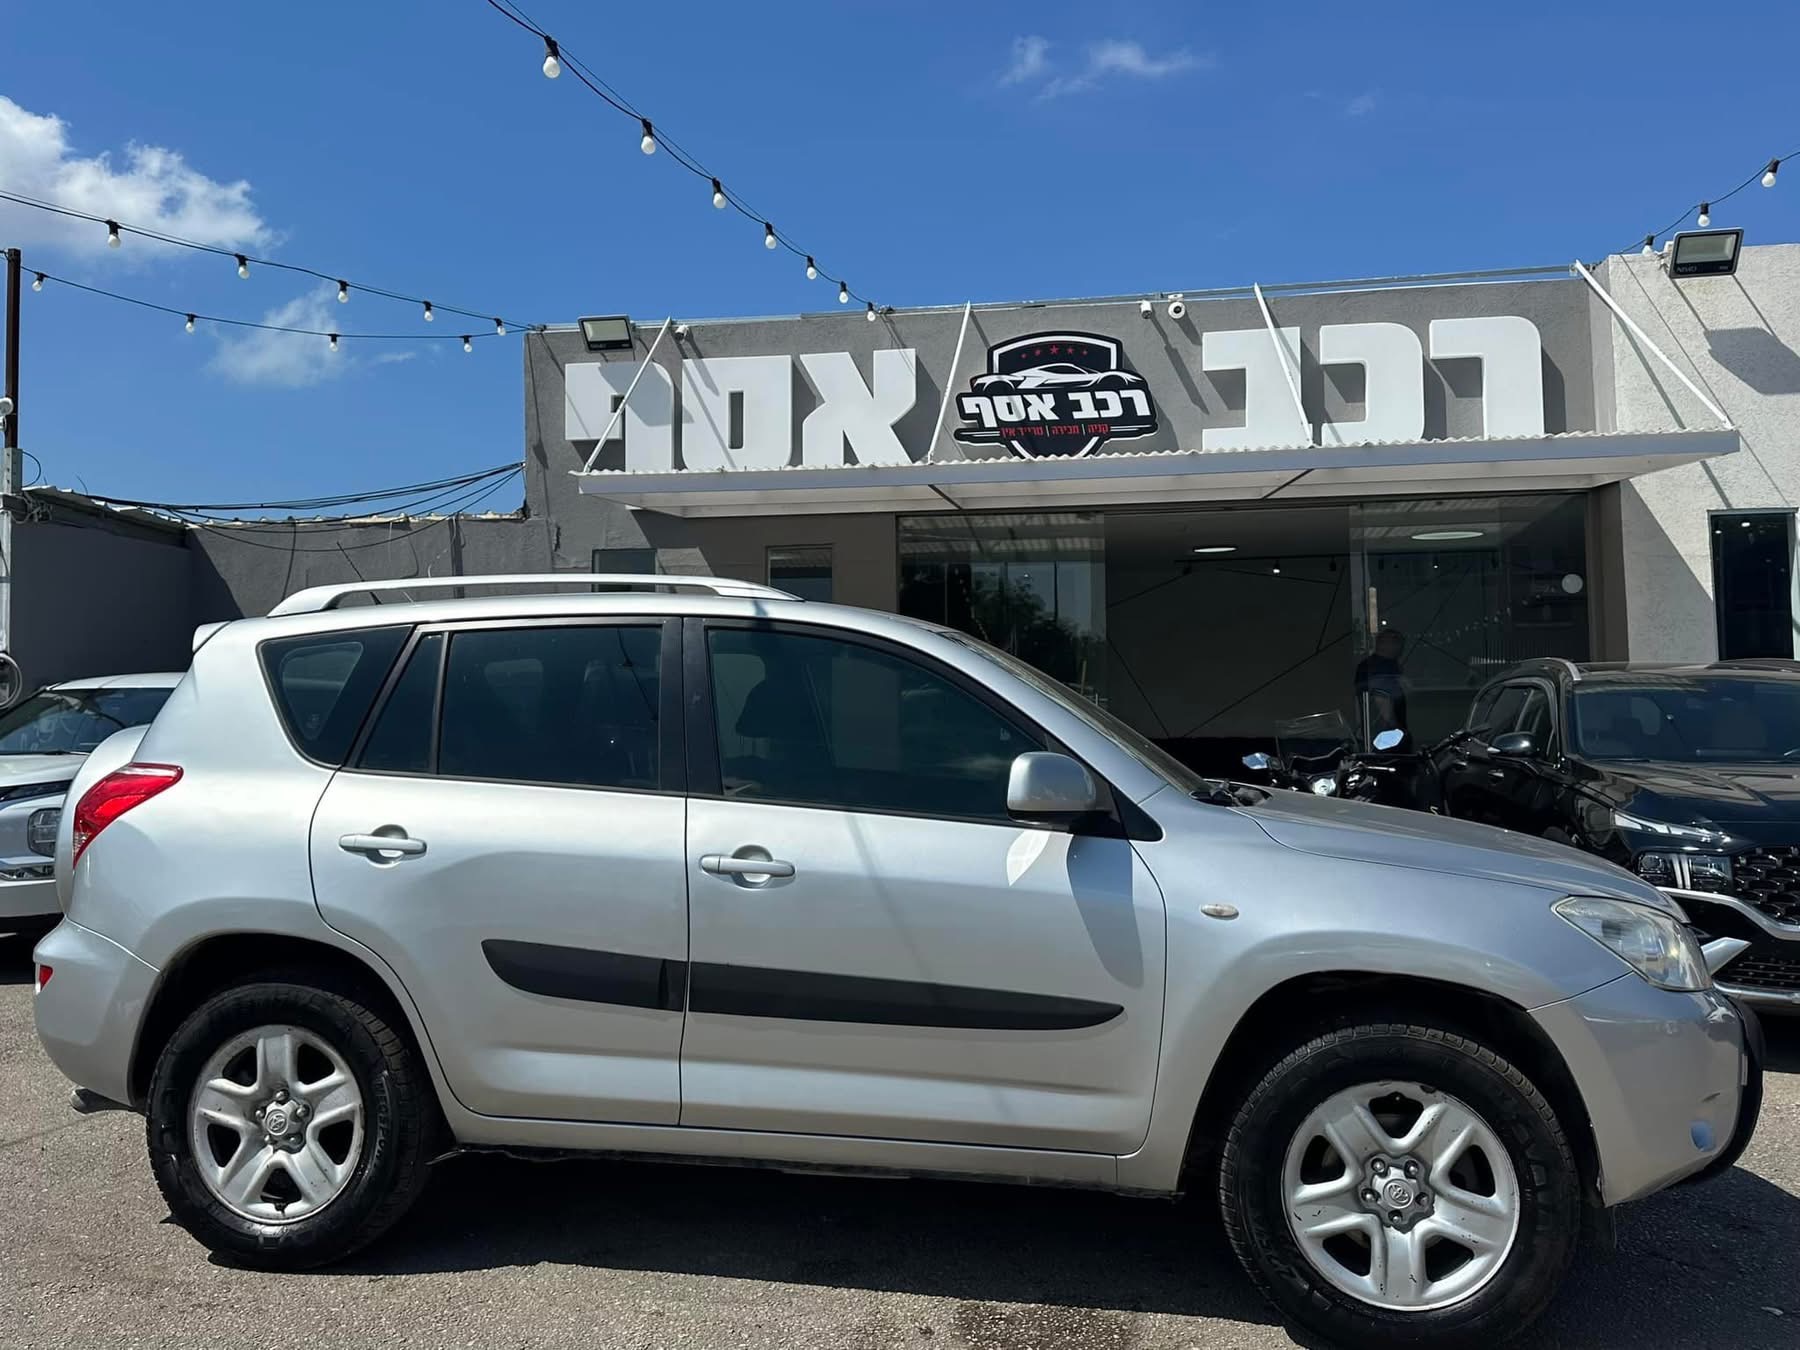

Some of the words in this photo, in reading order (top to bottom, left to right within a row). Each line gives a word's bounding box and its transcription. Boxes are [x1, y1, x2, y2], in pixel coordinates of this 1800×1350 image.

[565, 348, 916, 472] אסף
[961, 393, 1060, 428] אסף
[1068, 389, 1150, 420] רכב
[1202, 315, 1544, 450] רכב
